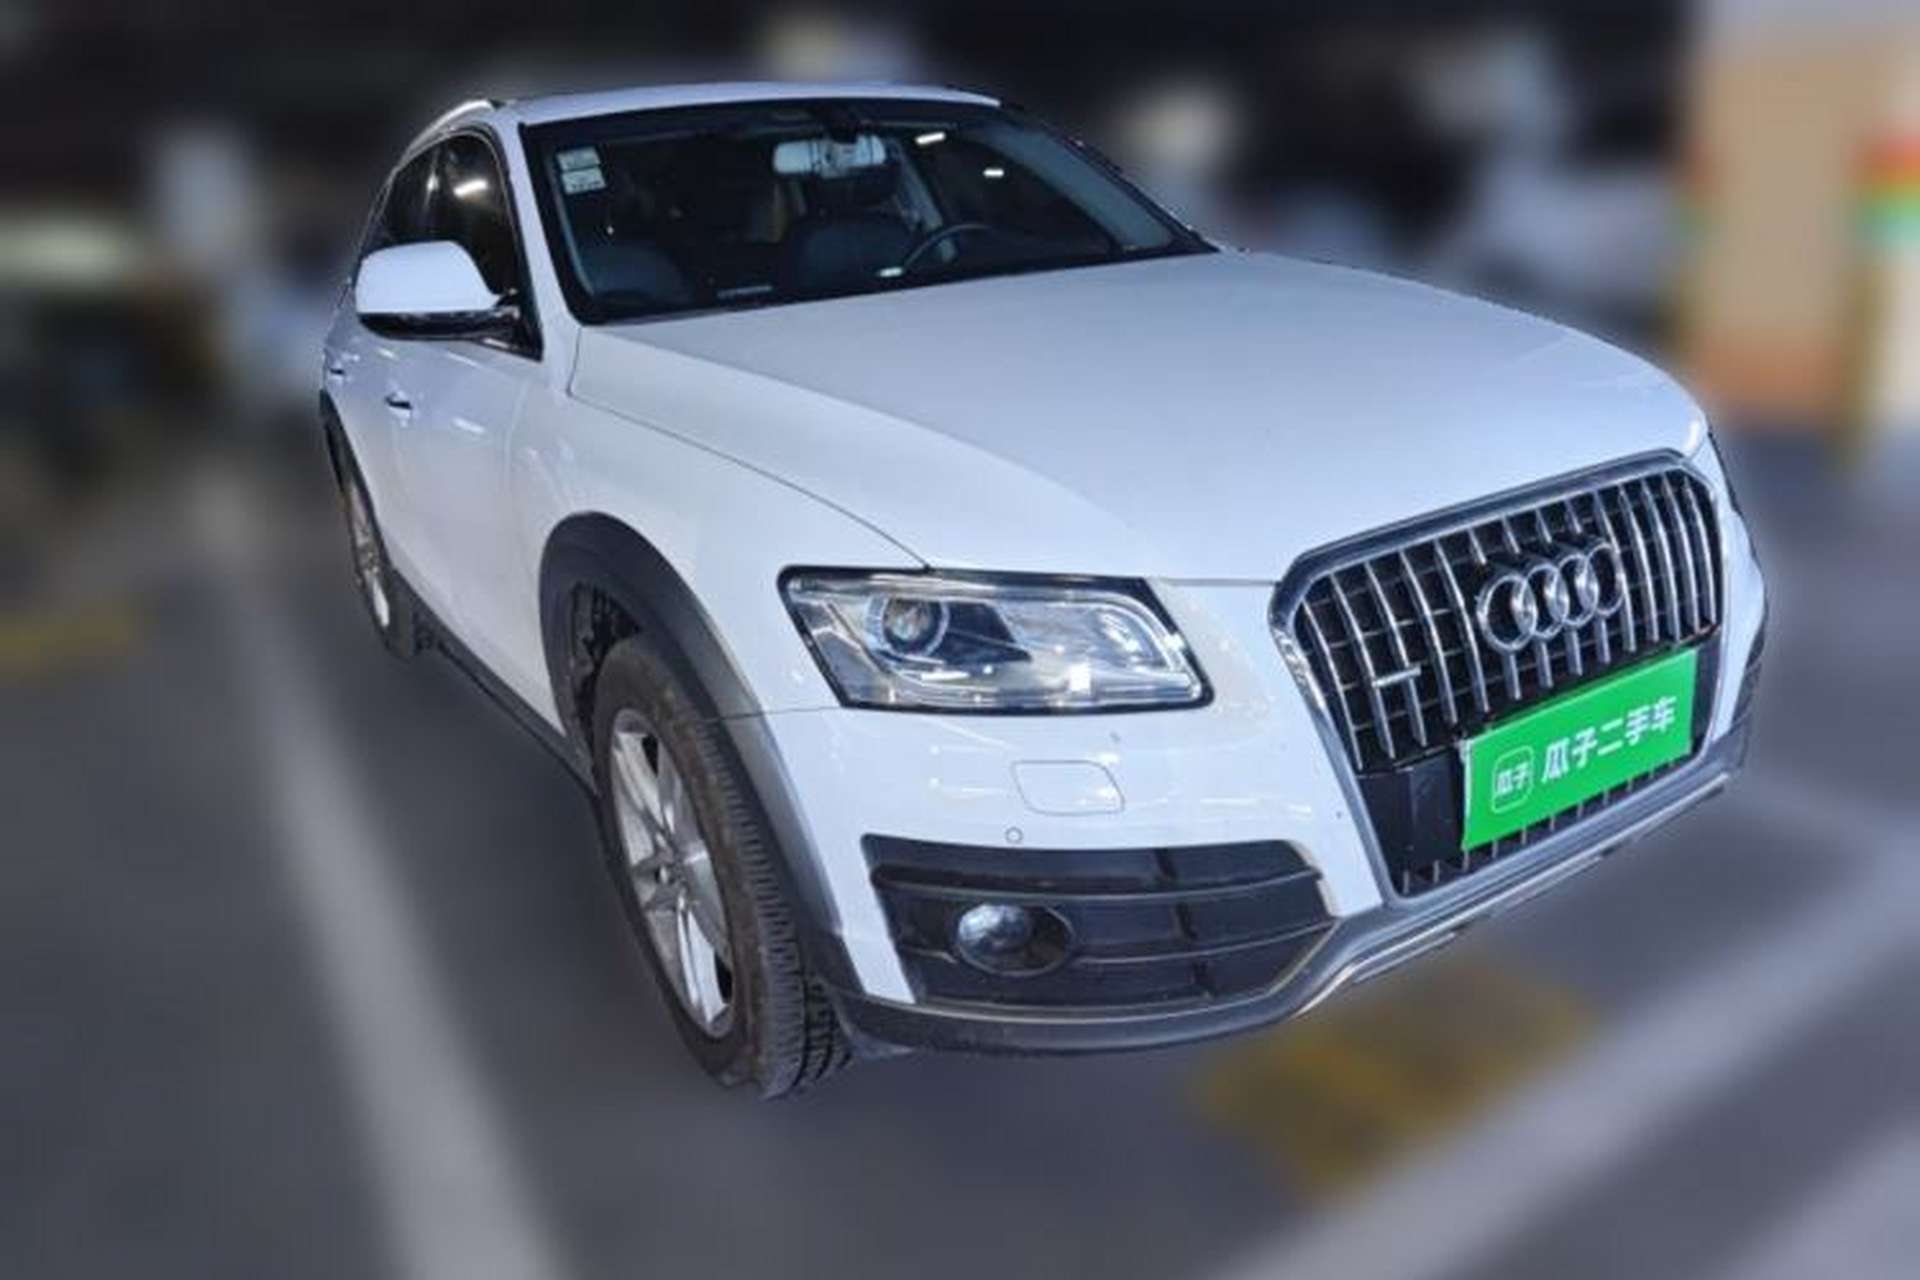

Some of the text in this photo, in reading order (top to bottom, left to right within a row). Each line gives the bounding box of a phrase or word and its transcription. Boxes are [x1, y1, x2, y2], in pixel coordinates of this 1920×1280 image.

[1542, 696, 1677, 783] 瓜子二手车
[1498, 762, 1530, 794] 瓜子
